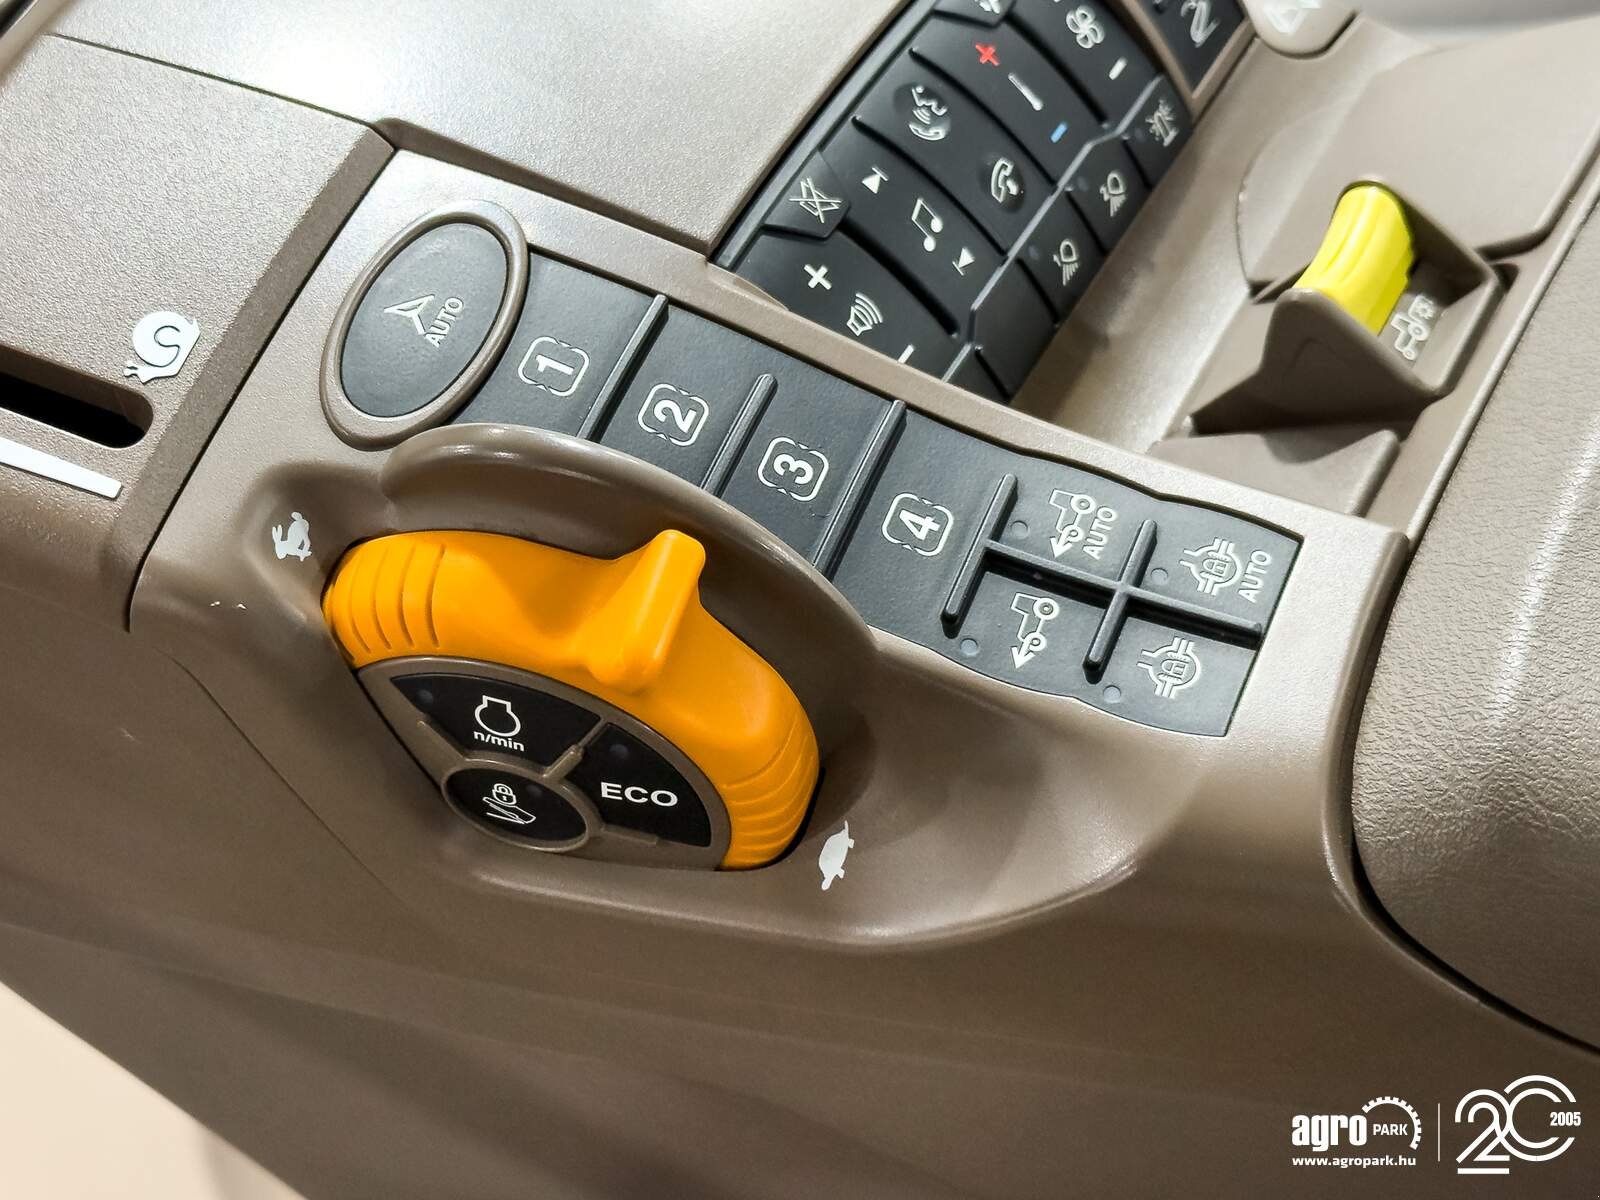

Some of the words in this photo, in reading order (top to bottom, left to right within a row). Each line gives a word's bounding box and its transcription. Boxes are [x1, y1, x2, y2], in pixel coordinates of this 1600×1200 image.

[425, 296, 465, 348] AUTO
[535, 353, 575, 375] 1
[653, 399, 697, 433] 2
[773, 452, 814, 485] 3
[899, 508, 941, 541] 4
[1082, 506, 1117, 560] AUTO
[1238, 550, 1273, 604] AUTO
[473, 730, 525, 751] n/min
[601, 781, 678, 807] ECO
